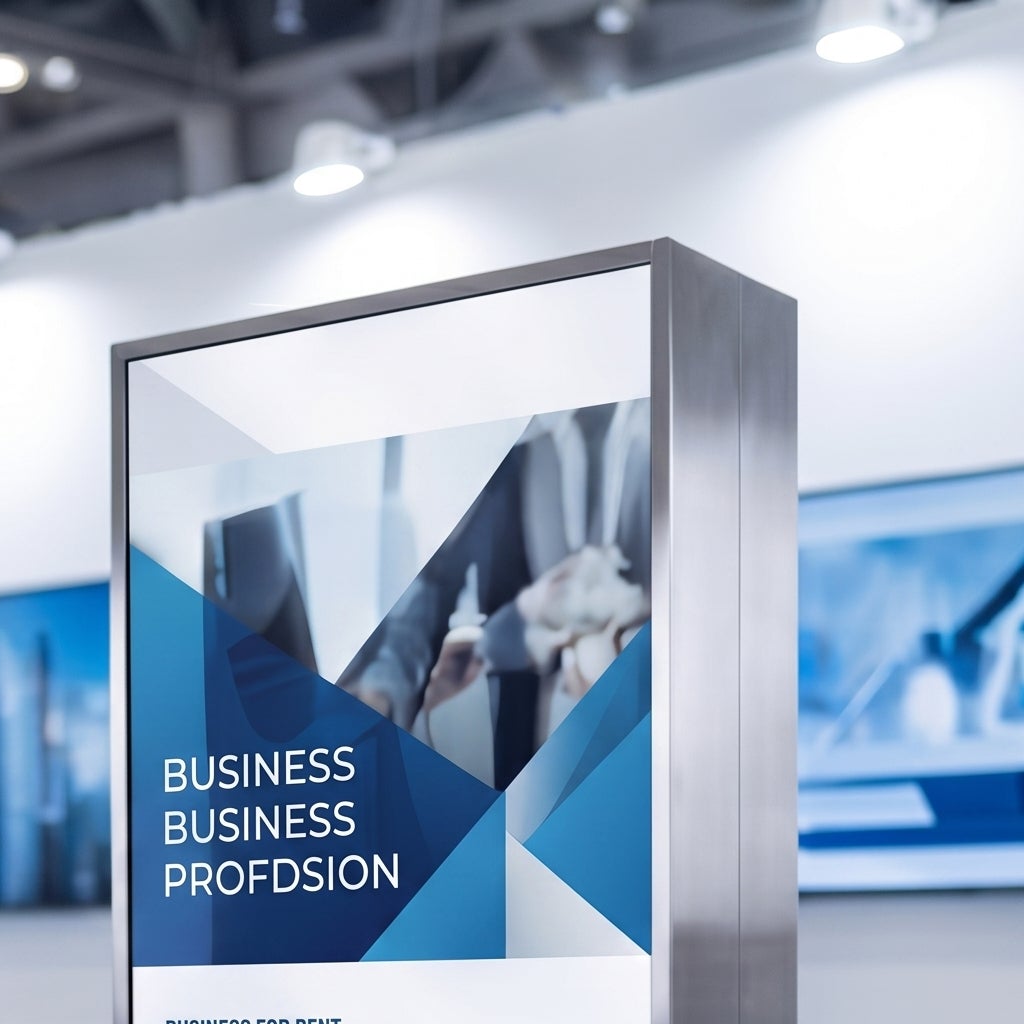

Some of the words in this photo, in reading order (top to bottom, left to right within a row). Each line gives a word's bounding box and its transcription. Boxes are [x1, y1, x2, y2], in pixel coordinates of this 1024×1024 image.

[164, 745, 356, 793] BUSINESS
[164, 800, 356, 845] BUSINESS
[164, 852, 399, 898] PROFDSION
